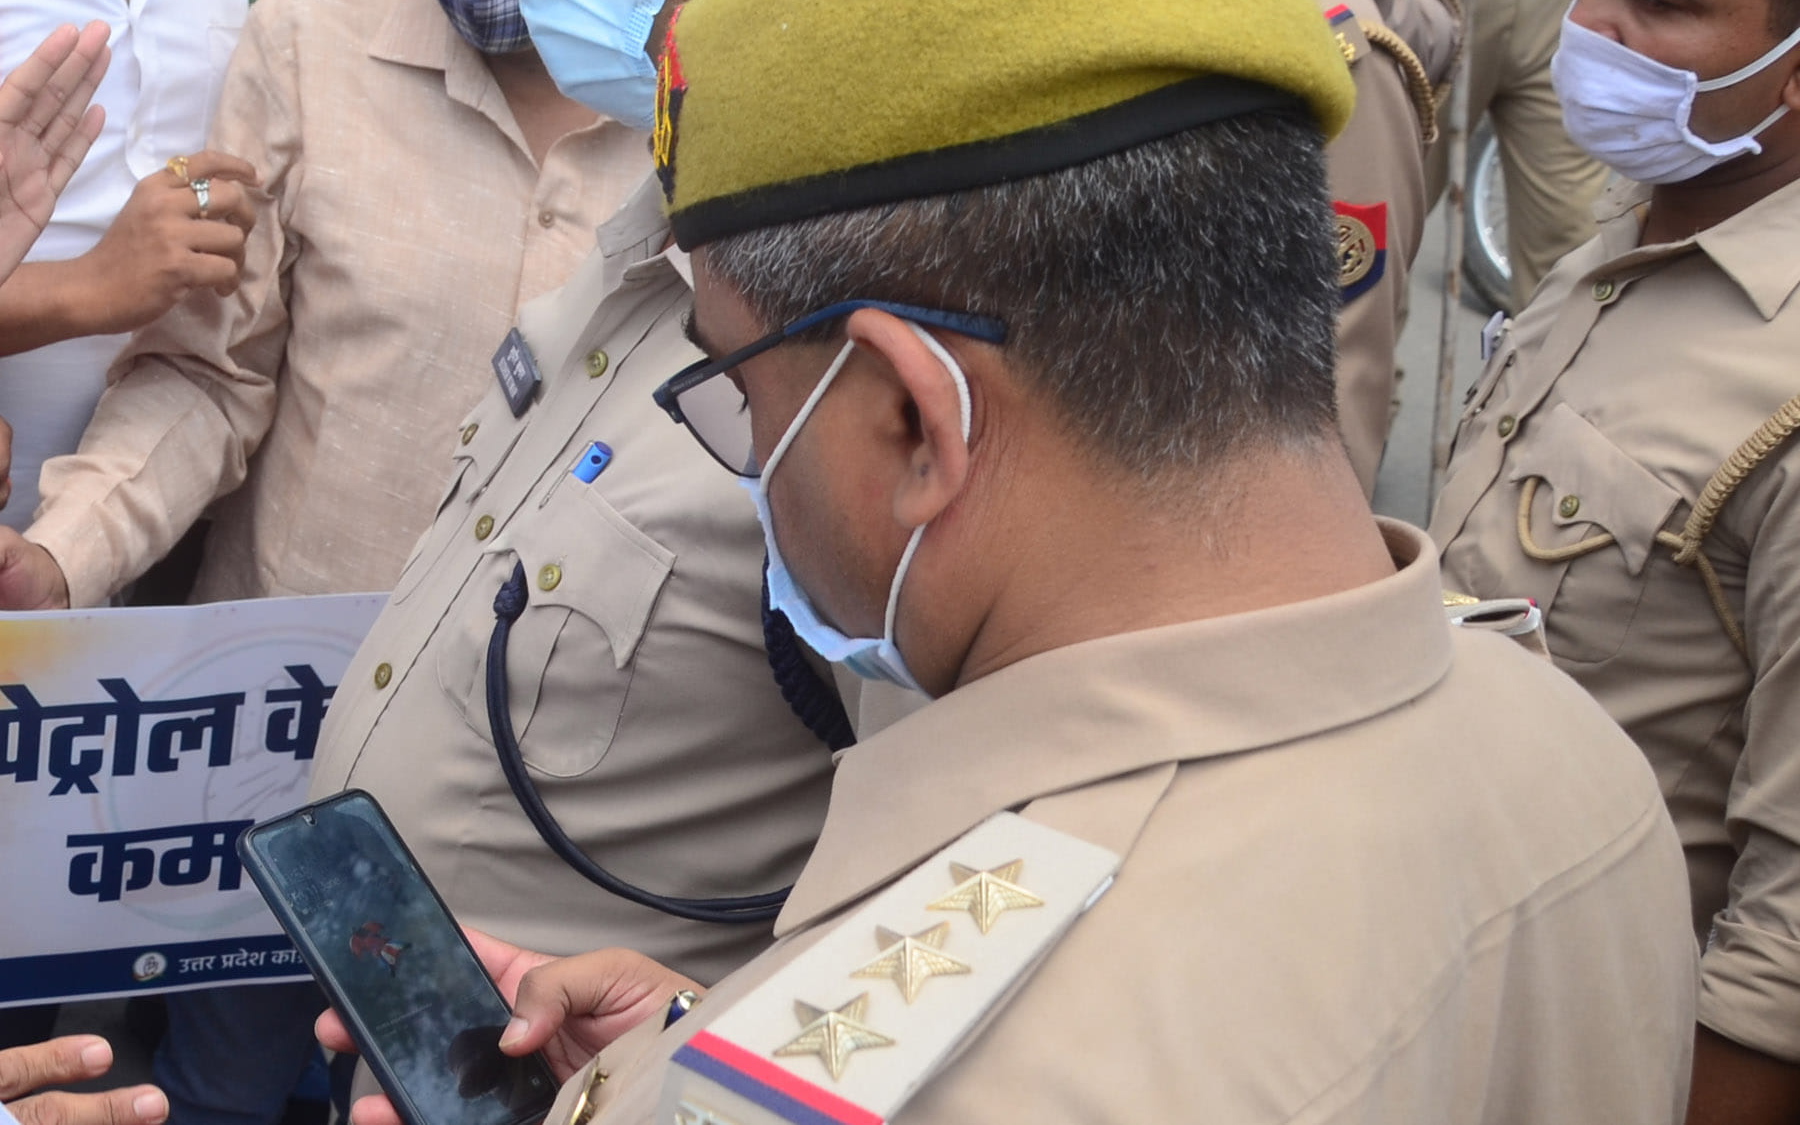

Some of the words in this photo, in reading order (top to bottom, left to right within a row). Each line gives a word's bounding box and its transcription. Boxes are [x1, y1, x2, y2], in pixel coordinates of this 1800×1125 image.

[66, 819, 256, 902] कम
[179, 955, 216, 974] उत्तर
[221, 947, 267, 970] प्रदेश
